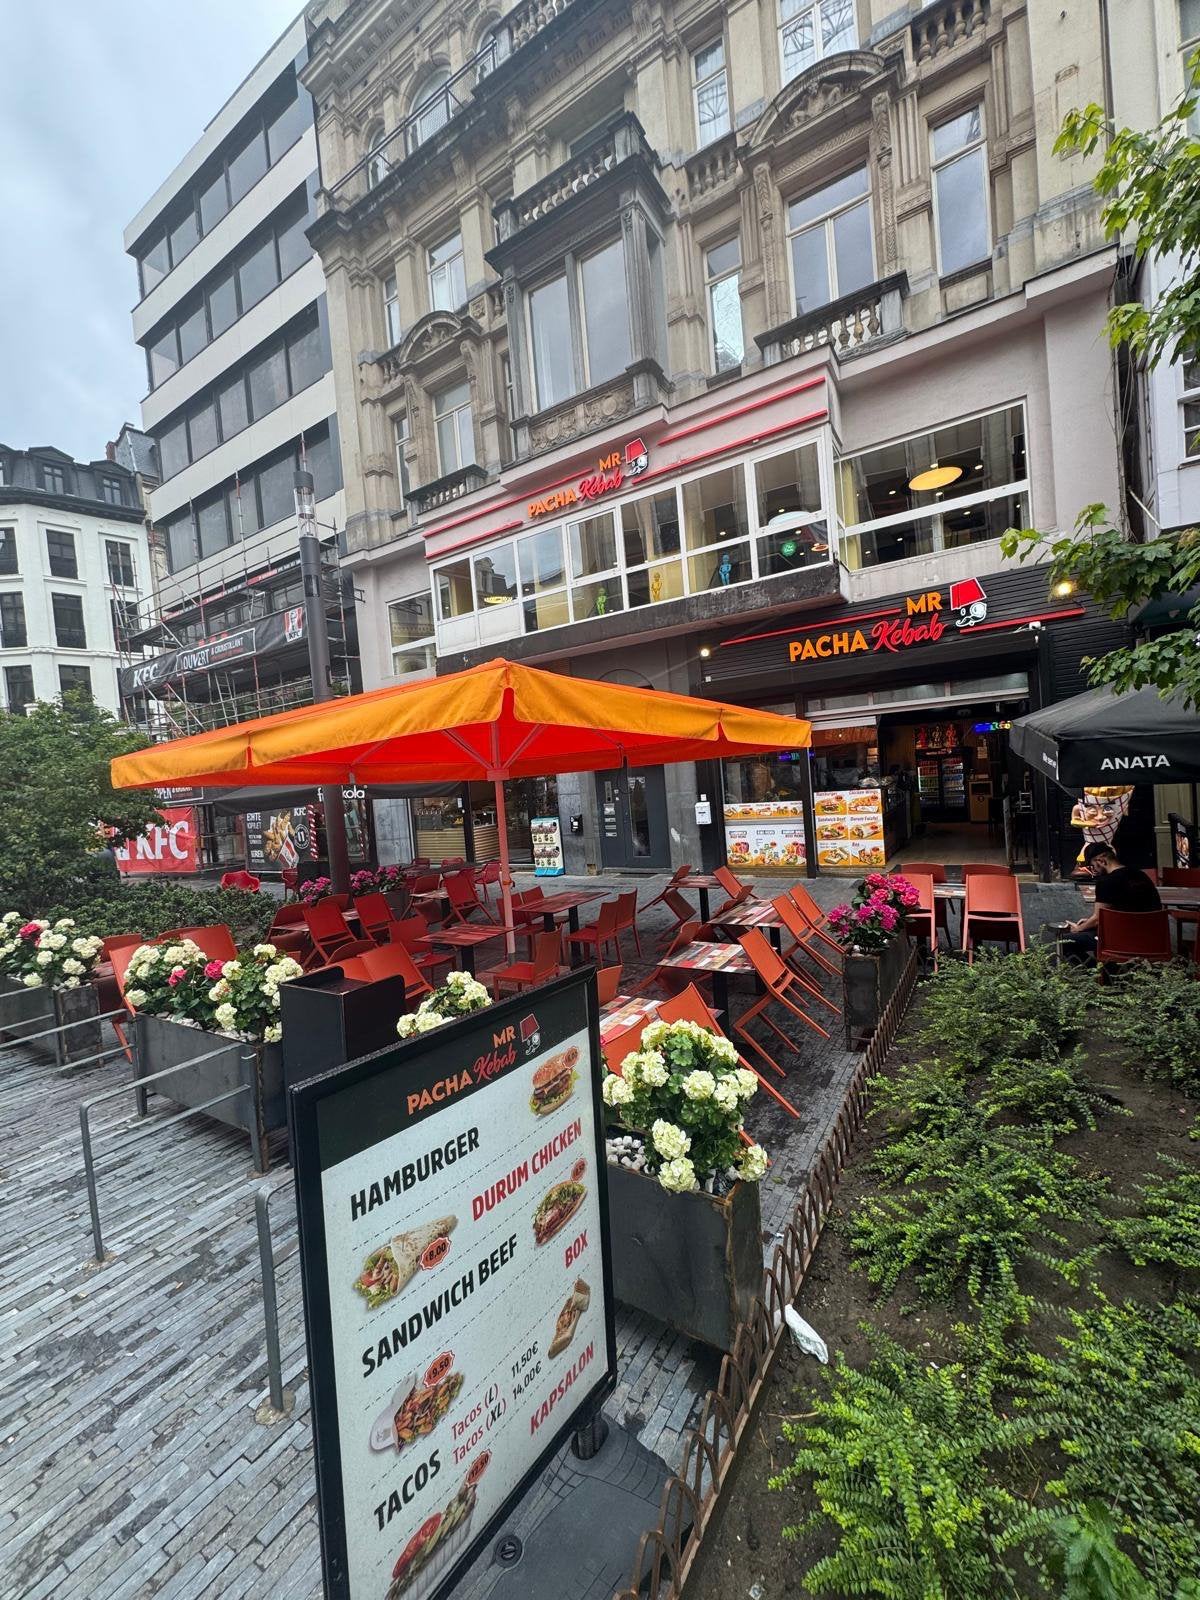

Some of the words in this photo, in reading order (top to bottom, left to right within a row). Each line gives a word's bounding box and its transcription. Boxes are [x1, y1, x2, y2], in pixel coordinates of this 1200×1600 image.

[599, 452, 622, 472] MR
[527, 488, 577, 518] PACHA
[578, 468, 625, 501] Kebab
[906, 592, 943, 616] MR
[183, 648, 210, 670] OUVERT
[789, 630, 869, 662] PACHA
[871, 613, 948, 653] Kebab
[132, 663, 159, 688] KFC
[1100, 754, 1171, 771] ANATA
[293, 806, 307, 816] KFC
[136, 820, 189, 860] KFC
[492, 1025, 517, 1048] MR
[406, 1069, 473, 1115] PACHA
[473, 1043, 518, 1084] Kebab
[350, 1126, 480, 1222] HAMBURGER
[471, 1160, 529, 1222] DURUM
[531, 1118, 582, 1175] CHICKEN
[564, 1229, 589, 1269] BOX
[361, 1270, 475, 1379] SANDWICH
[478, 1233, 517, 1287] BEEF
[451, 1403, 482, 1441] Tacos
[484, 1383, 499, 1411] (L)
[511, 1340, 540, 1378] 11,50€
[452, 1426, 484, 1465] Tacos
[485, 1398, 507, 1430] (XL)
[512, 1360, 543, 1400] 14,00€
[530, 1341, 594, 1436] KAPSALON
[373, 1449, 441, 1532] TACOS
